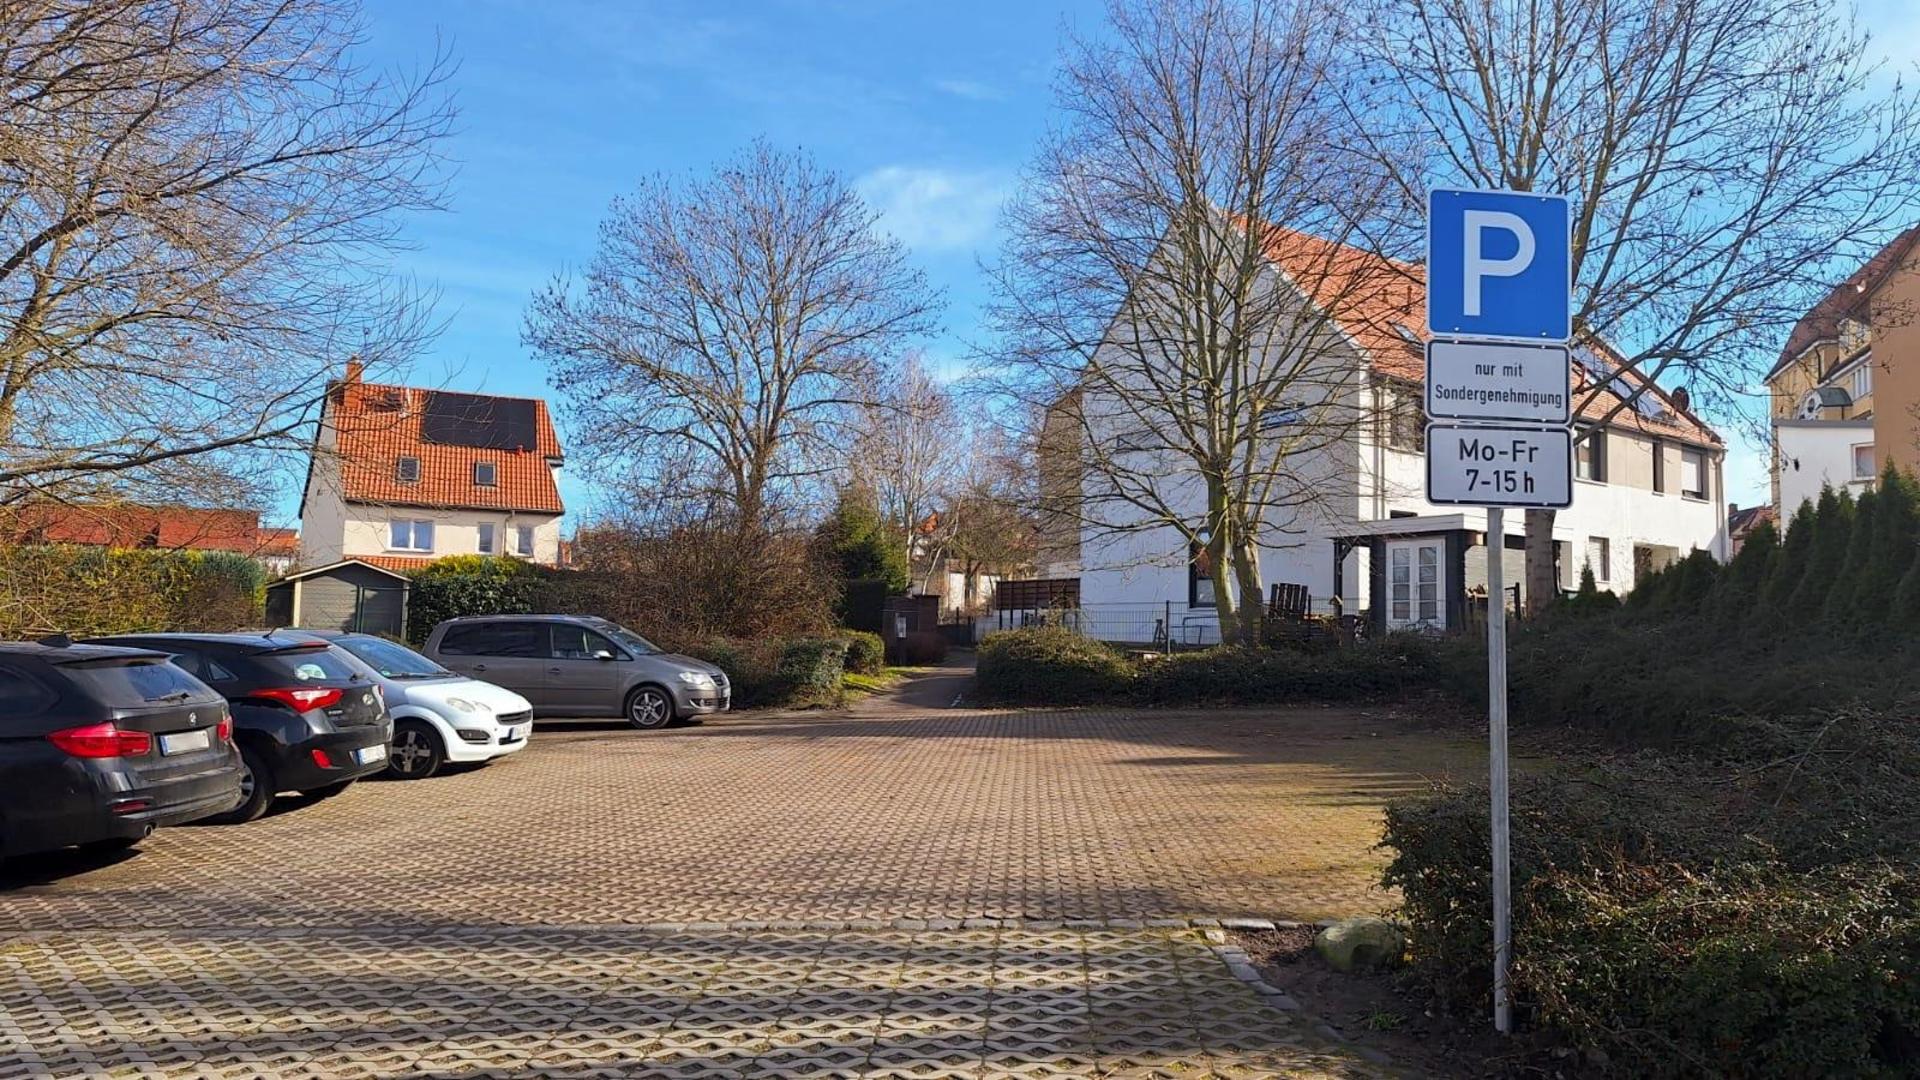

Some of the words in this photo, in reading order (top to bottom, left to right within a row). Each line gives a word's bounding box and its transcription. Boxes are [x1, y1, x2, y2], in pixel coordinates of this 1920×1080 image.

[1463, 209, 1536, 316] P
[1475, 363, 1496, 377] nur
[1502, 362, 1523, 378] mit
[1435, 384, 1562, 408] Sondergenehmigung
[1459, 438, 1539, 463] Mo-Fr
[1466, 469, 1517, 493] 7-15
[1524, 470, 1534, 494] h
